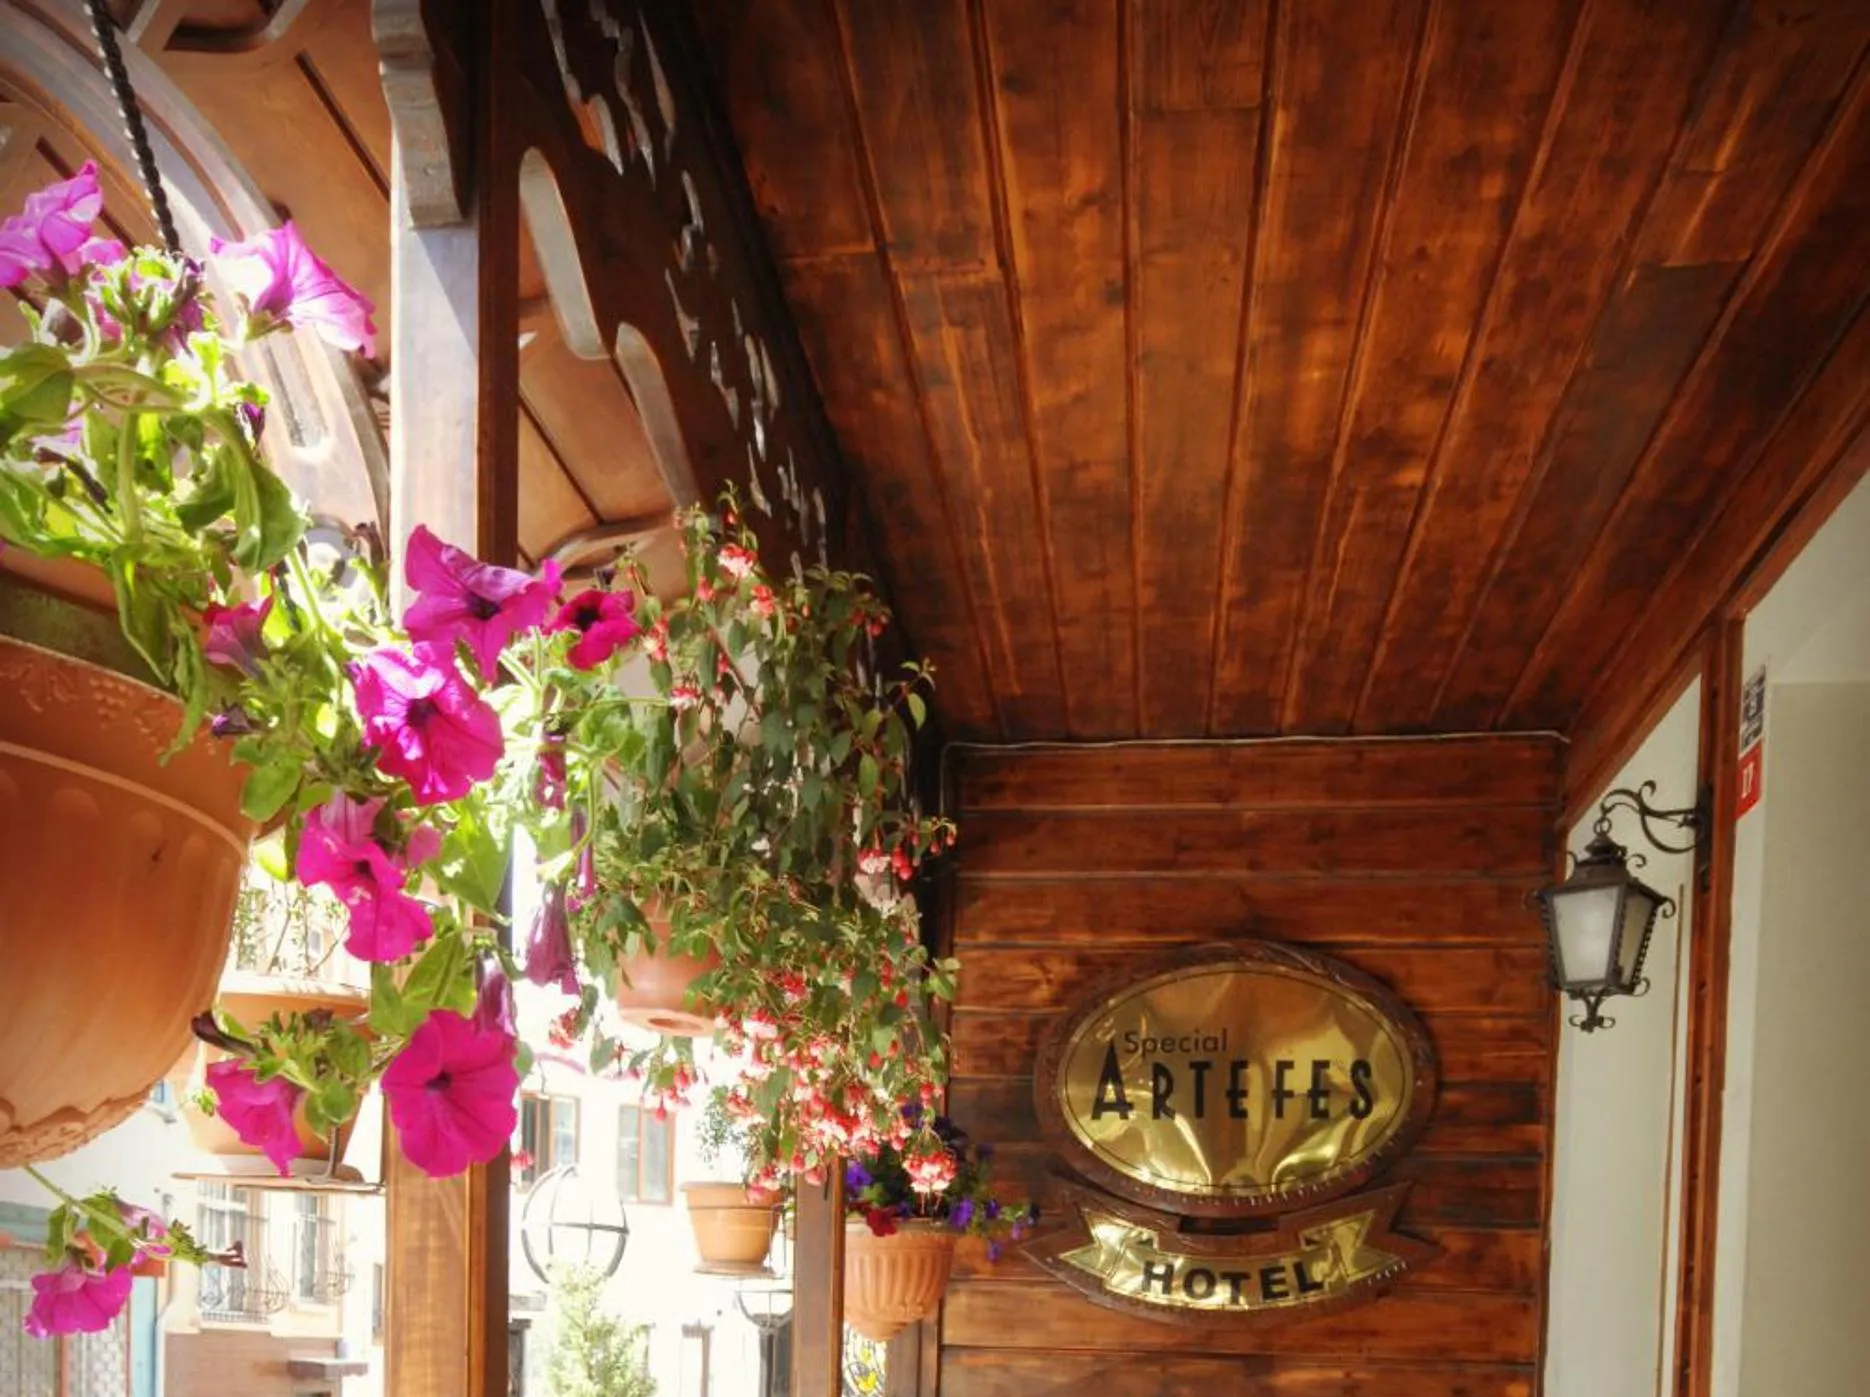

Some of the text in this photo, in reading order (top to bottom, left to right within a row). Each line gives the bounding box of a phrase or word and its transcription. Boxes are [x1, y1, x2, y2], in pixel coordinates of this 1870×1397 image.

[1124, 1027, 1228, 1058] Special
[1091, 1040, 1374, 1121] ARTEFES
[1140, 1260, 1324, 1305] HOTEL
